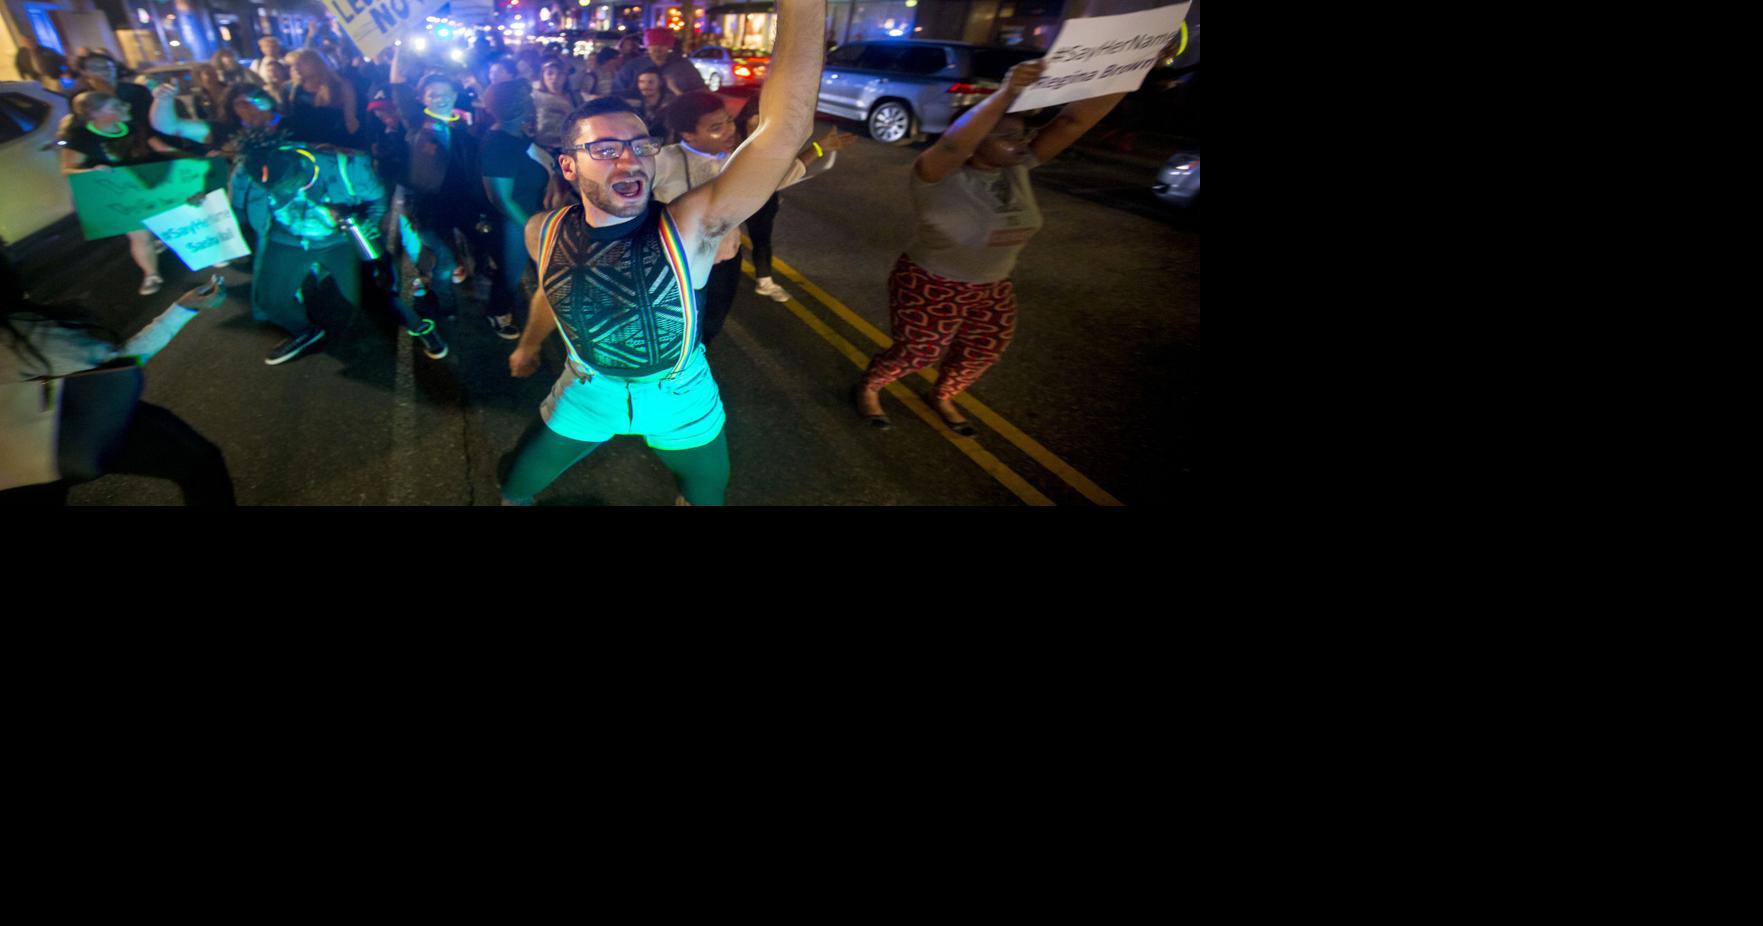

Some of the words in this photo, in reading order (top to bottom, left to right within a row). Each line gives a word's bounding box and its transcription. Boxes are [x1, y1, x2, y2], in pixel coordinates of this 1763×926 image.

[331, 0, 373, 24] LE
[369, 0, 424, 34] NO
[1097, 57, 1156, 80] Brown
